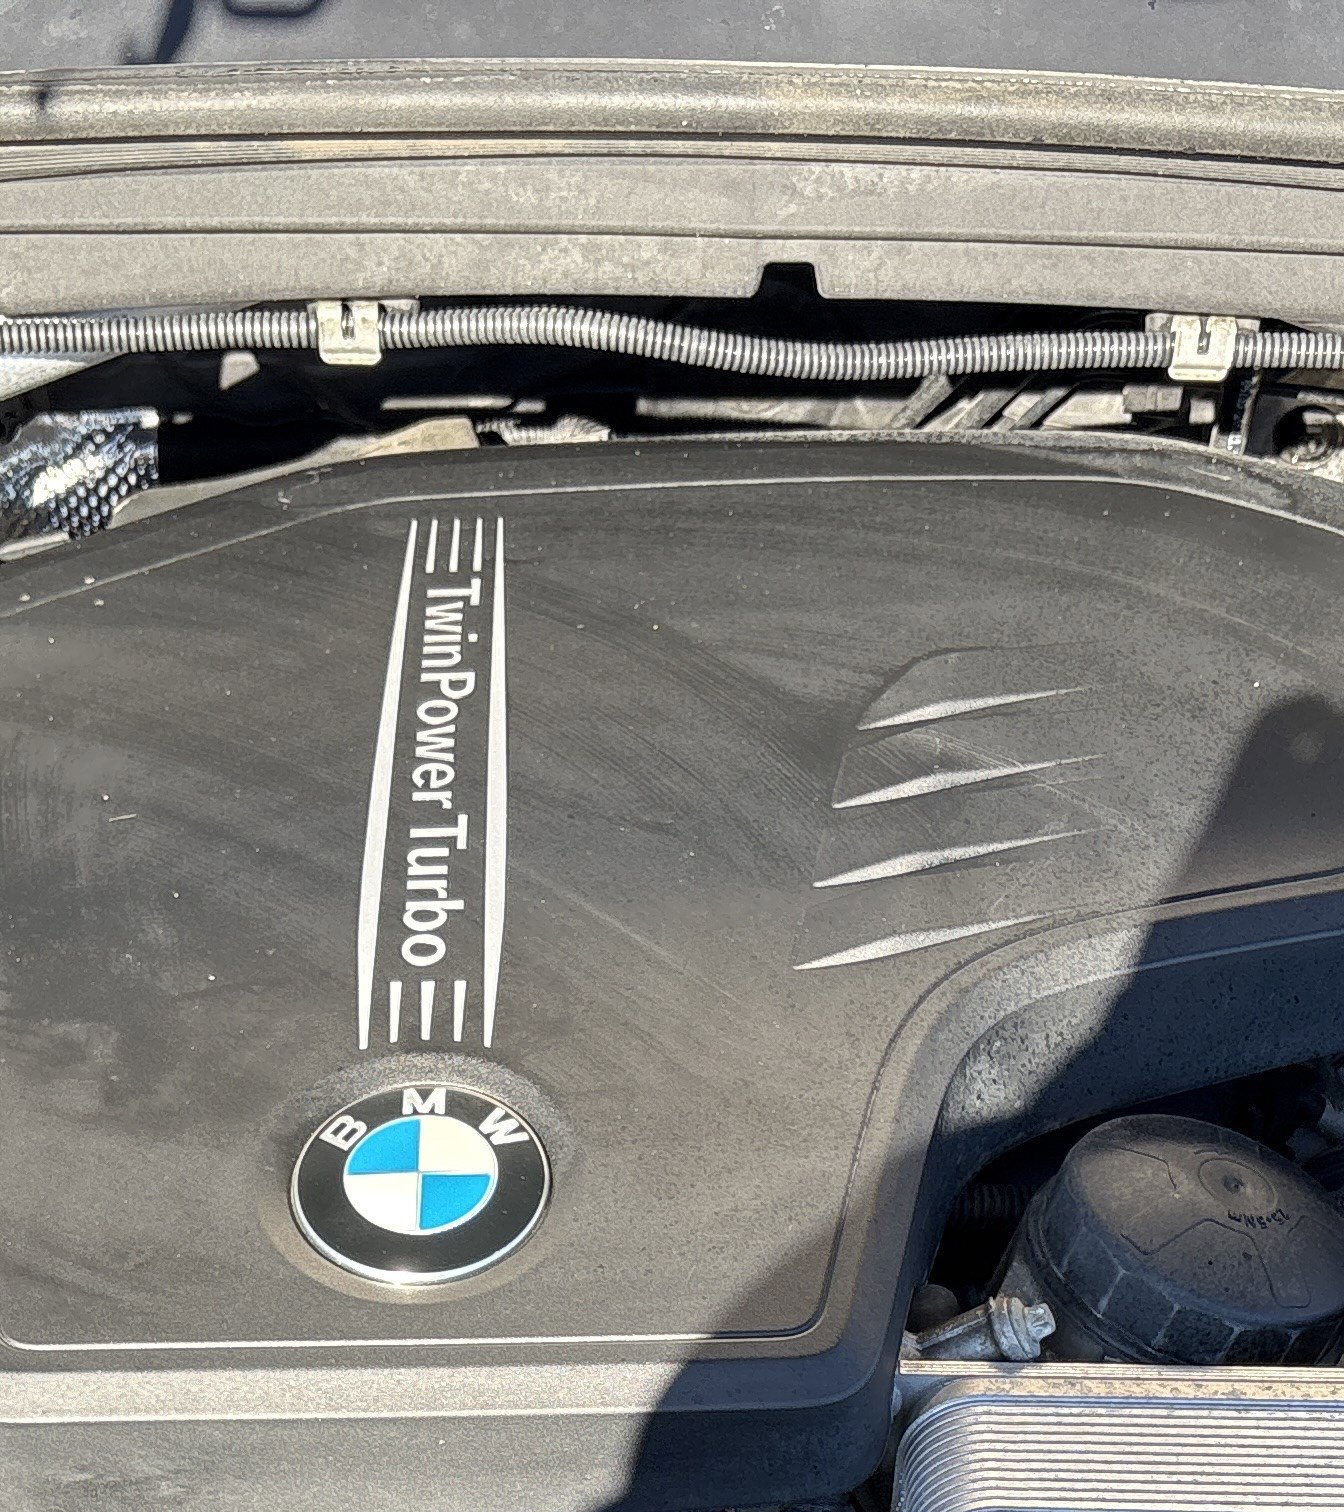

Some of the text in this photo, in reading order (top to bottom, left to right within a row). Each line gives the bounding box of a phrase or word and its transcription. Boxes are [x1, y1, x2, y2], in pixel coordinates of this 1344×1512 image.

[401, 578, 482, 967] TwinPower Turbo
[320, 1087, 528, 1150] BMW
